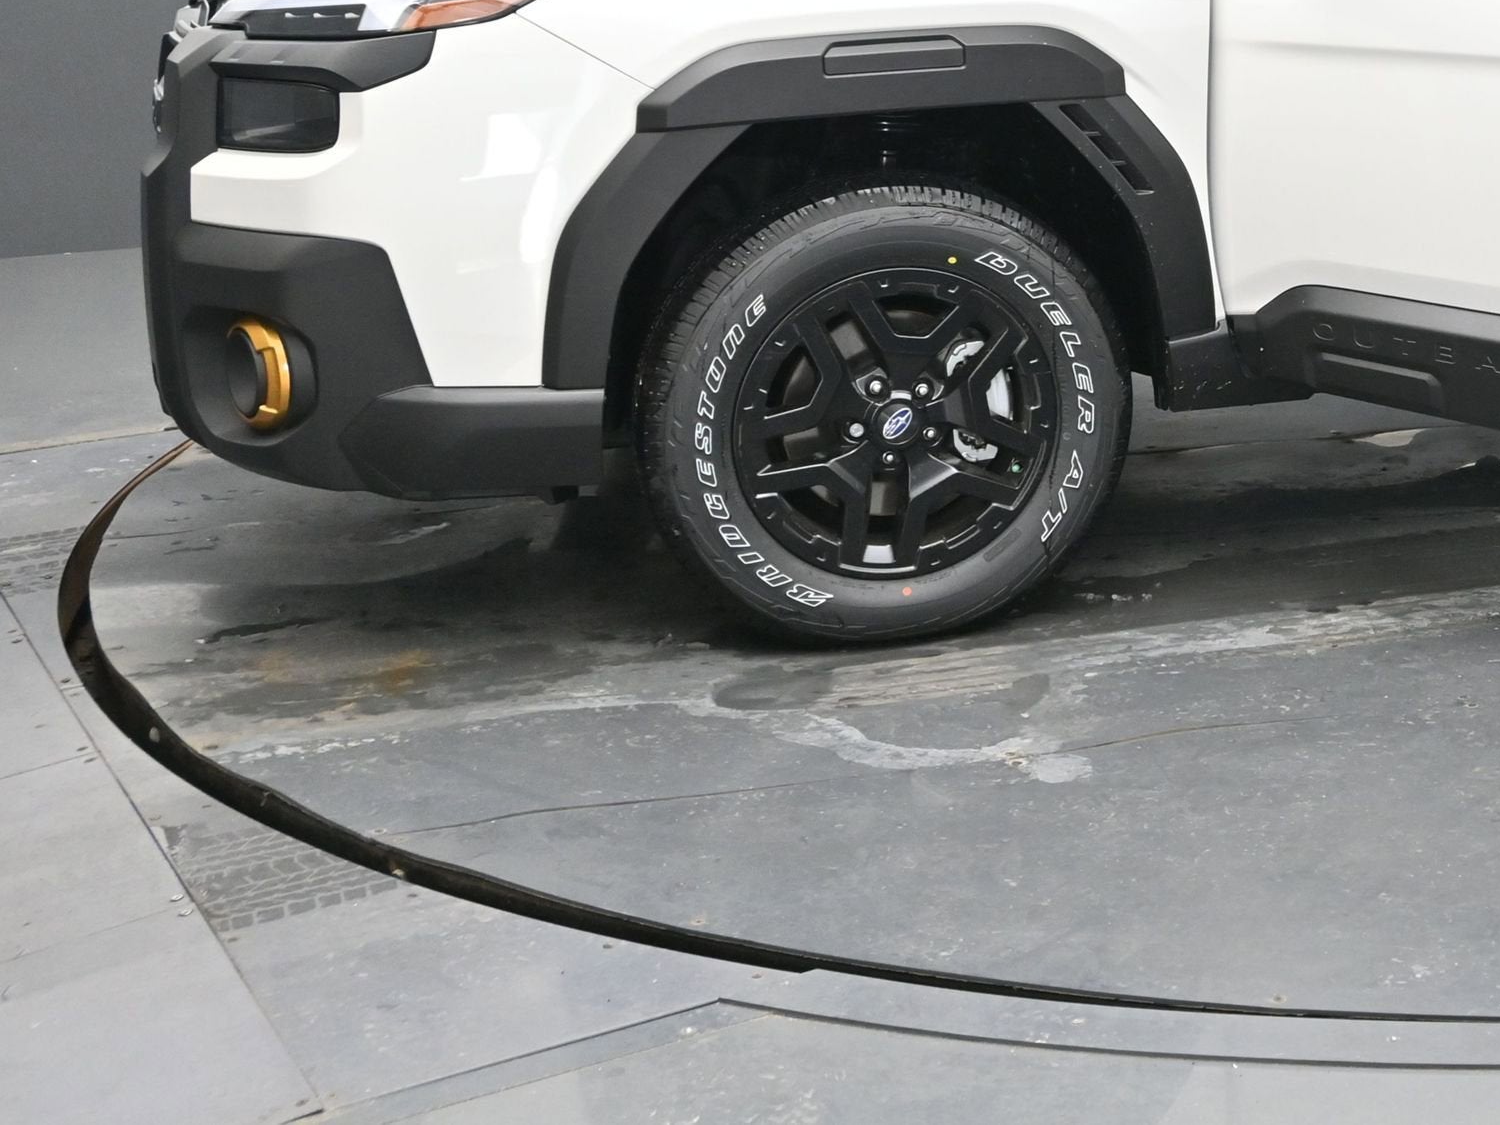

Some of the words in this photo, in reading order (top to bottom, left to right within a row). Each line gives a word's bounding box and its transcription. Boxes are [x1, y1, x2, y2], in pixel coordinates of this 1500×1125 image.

[695, 295, 834, 607] BRIDGESTONE
[975, 252, 1095, 435] DUELER
[1041, 450, 1083, 542] A/T
